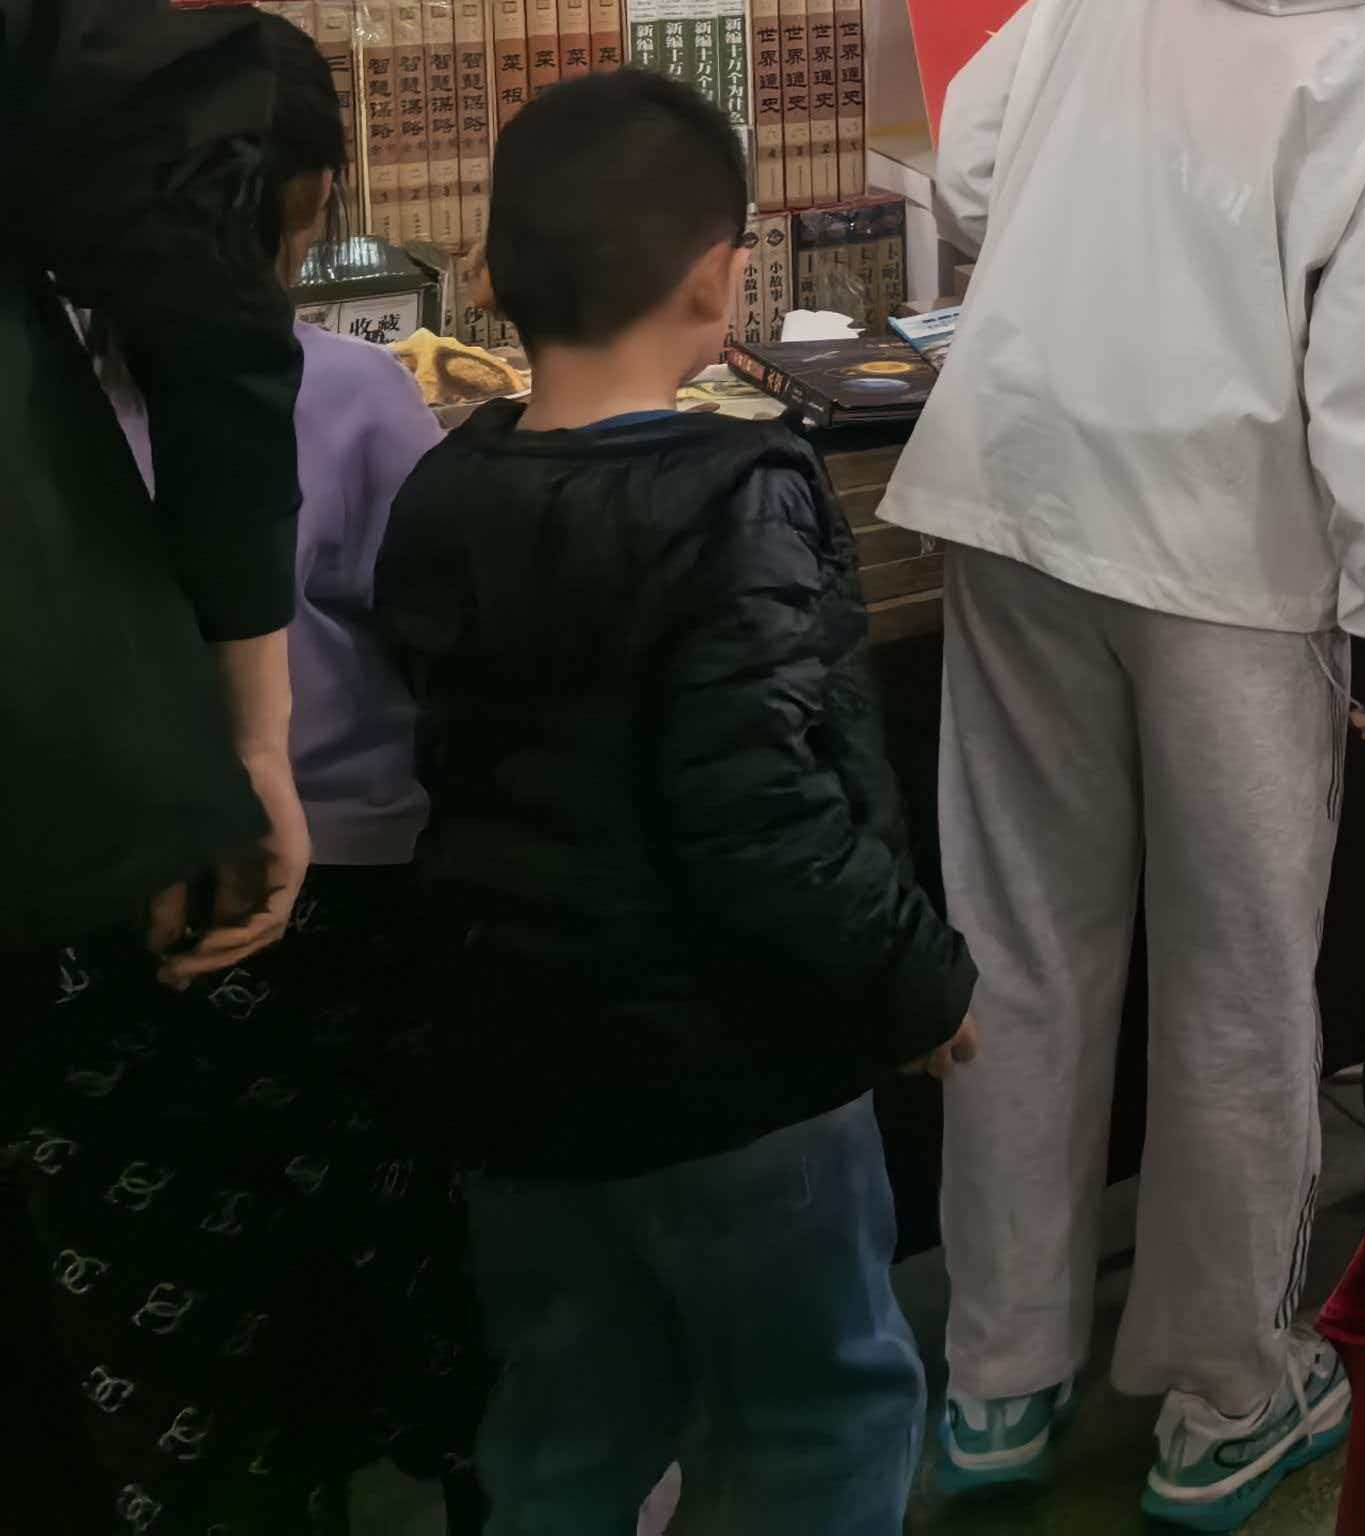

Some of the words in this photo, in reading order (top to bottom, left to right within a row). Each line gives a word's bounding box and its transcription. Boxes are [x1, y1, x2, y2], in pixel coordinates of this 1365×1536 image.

[724, 17, 746, 126] 新编十万个为什么
[756, 27, 781, 114] 世界通史
[783, 25, 808, 112] 世界通史
[811, 23, 836, 109] 世界通史
[839, 21, 864, 107] 世界通史
